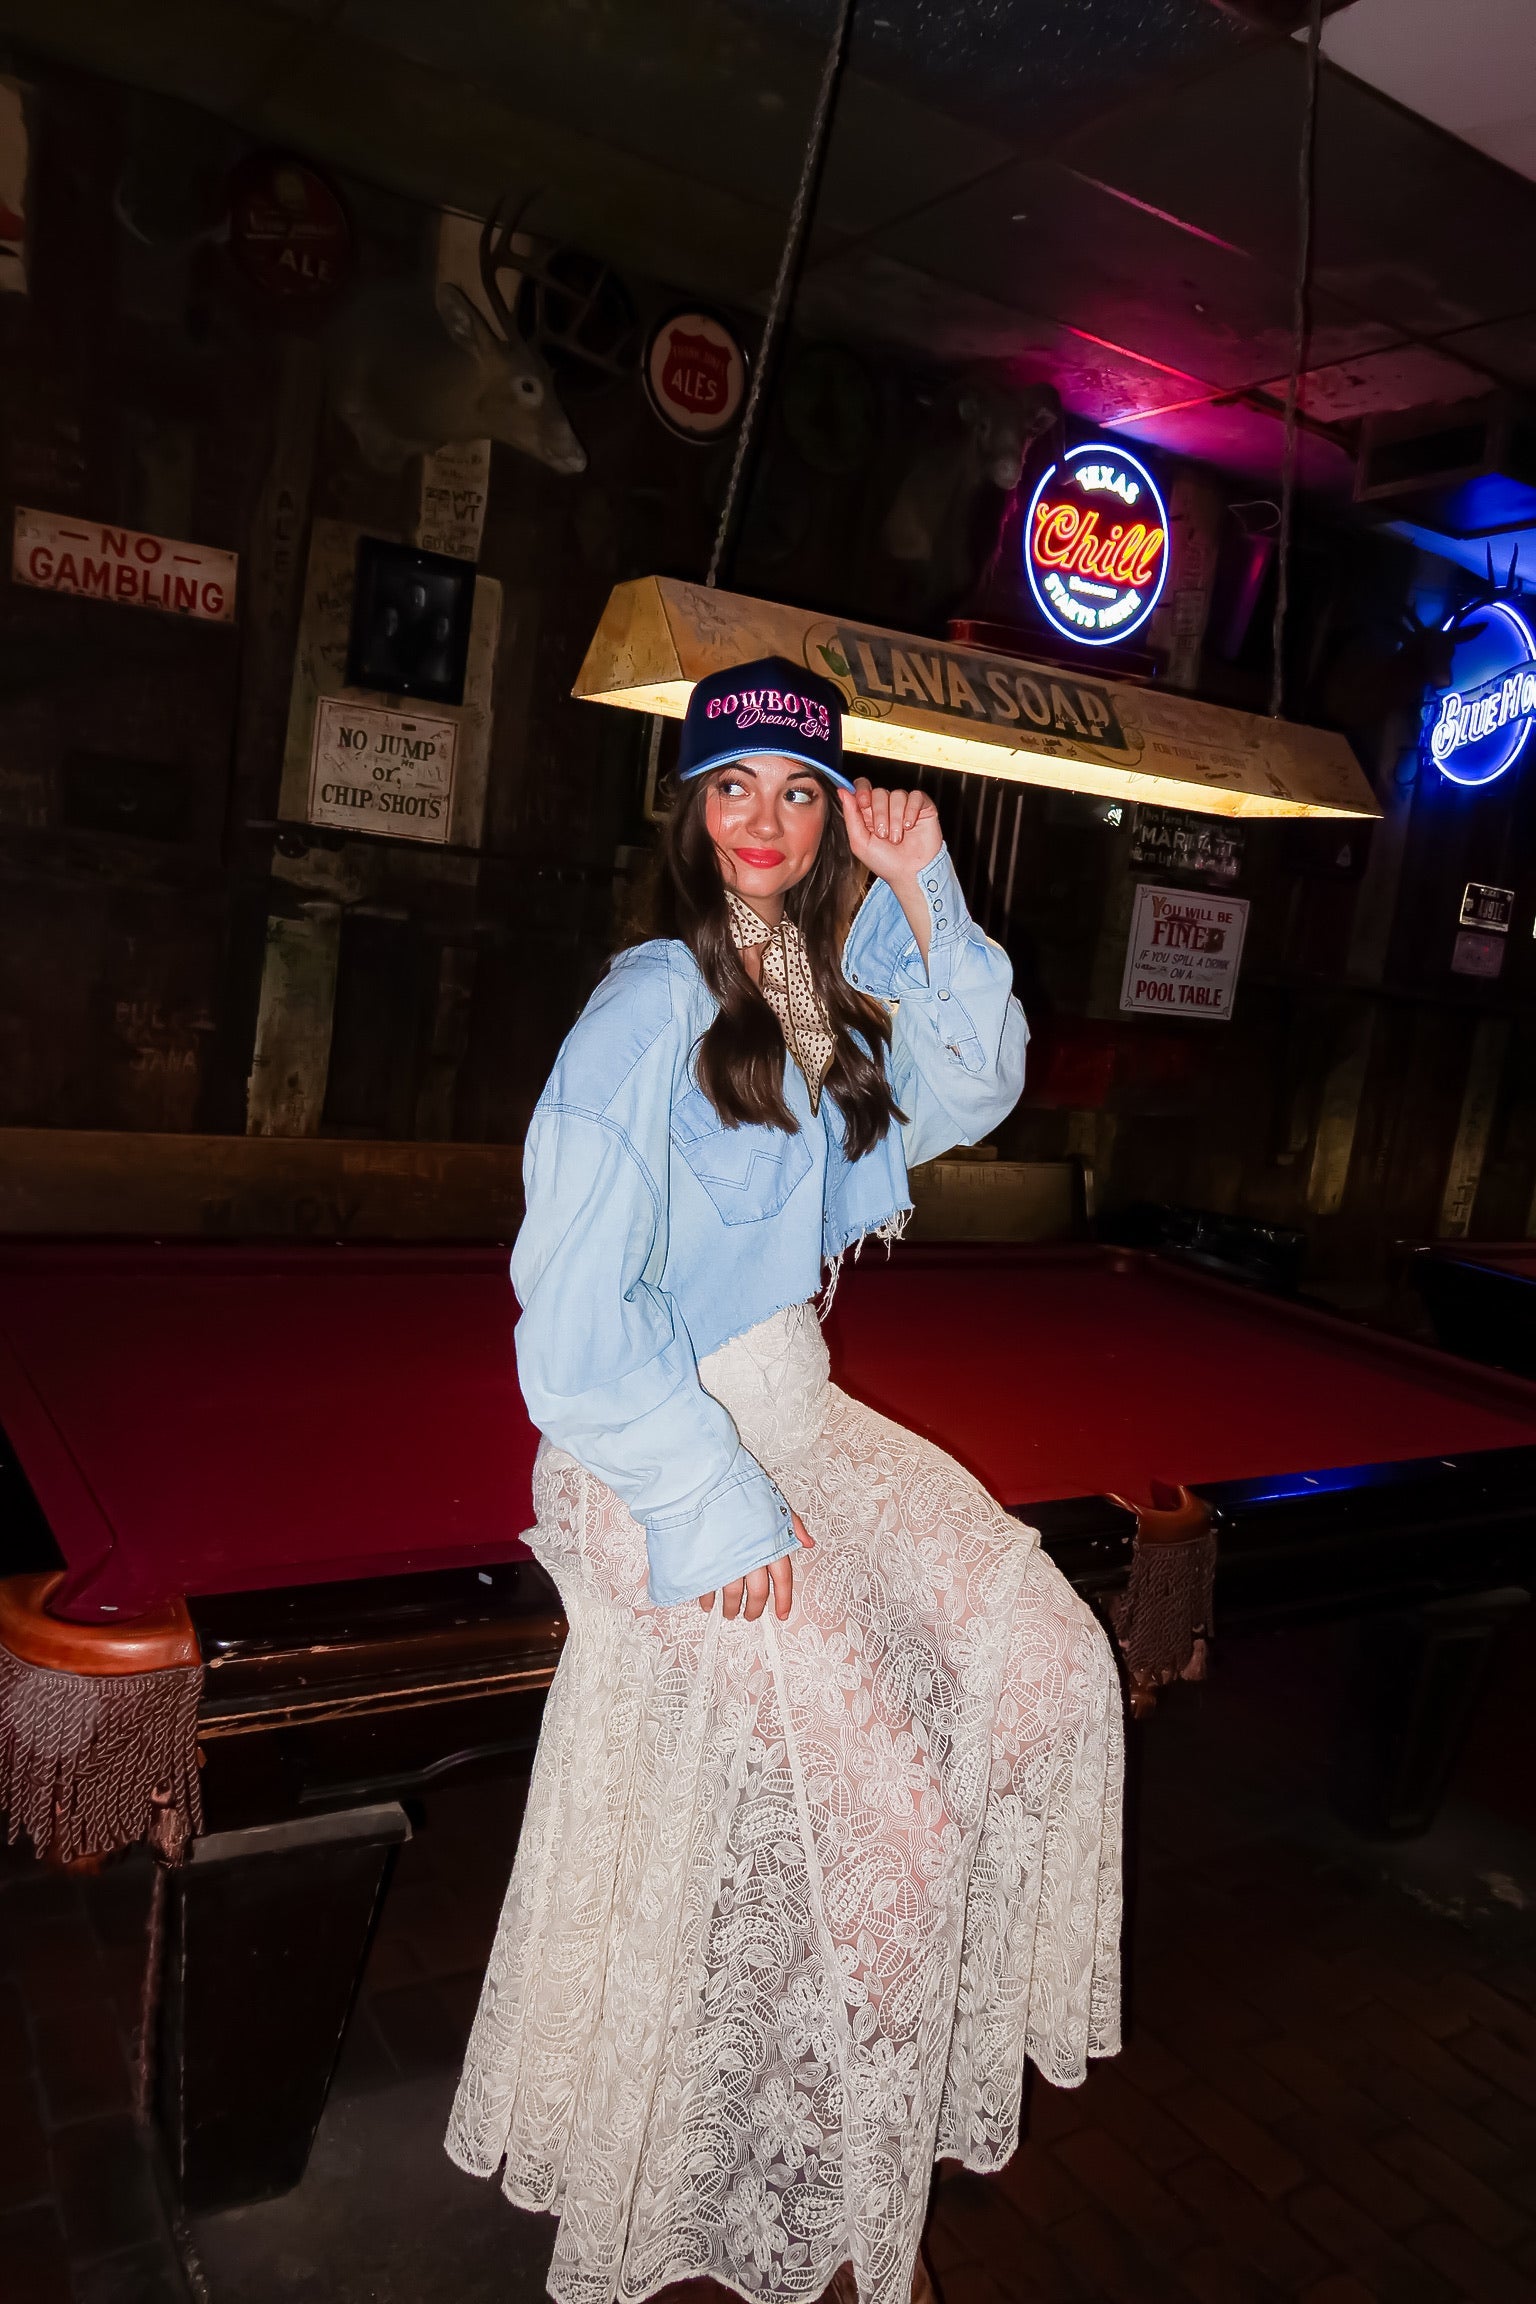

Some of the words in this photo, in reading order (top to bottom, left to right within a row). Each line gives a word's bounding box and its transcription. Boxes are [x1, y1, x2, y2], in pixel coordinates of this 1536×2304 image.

[671, 368, 718, 401] ALES
[1075, 465, 1140, 504] TEXAS
[101, 529, 163, 564] NO
[1034, 502, 1165, 585] Chill
[29, 546, 224, 614] GAMBLING
[855, 640, 986, 714] LAVA
[986, 670, 1111, 739] SOAP
[1498, 672, 1536, 726] MO
[706, 689, 830, 727] COWBOY'S
[736, 707, 798, 729] Dream
[799, 718, 830, 741] Girl
[338, 727, 368, 750] NO
[375, 733, 436, 761] JUMP
[321, 783, 373, 808] CHIP
[379, 793, 441, 819] SHOTS
[1152, 895, 1182, 918] YOU
[1186, 906, 1214, 921] WILL
[1217, 911, 1233, 924] BE
[1138, 950, 1150, 961] IF
[1152, 951, 1170, 963] YOU
[1172, 953, 1193, 967] SPILL
[1196, 958, 1203, 968] A
[1205, 957, 1230, 970] DRINK
[1170, 967, 1185, 979] ON
[1185, 970, 1193, 980] A
[1135, 980, 1175, 1002] POOL
[1179, 984, 1223, 1006] TABLE
